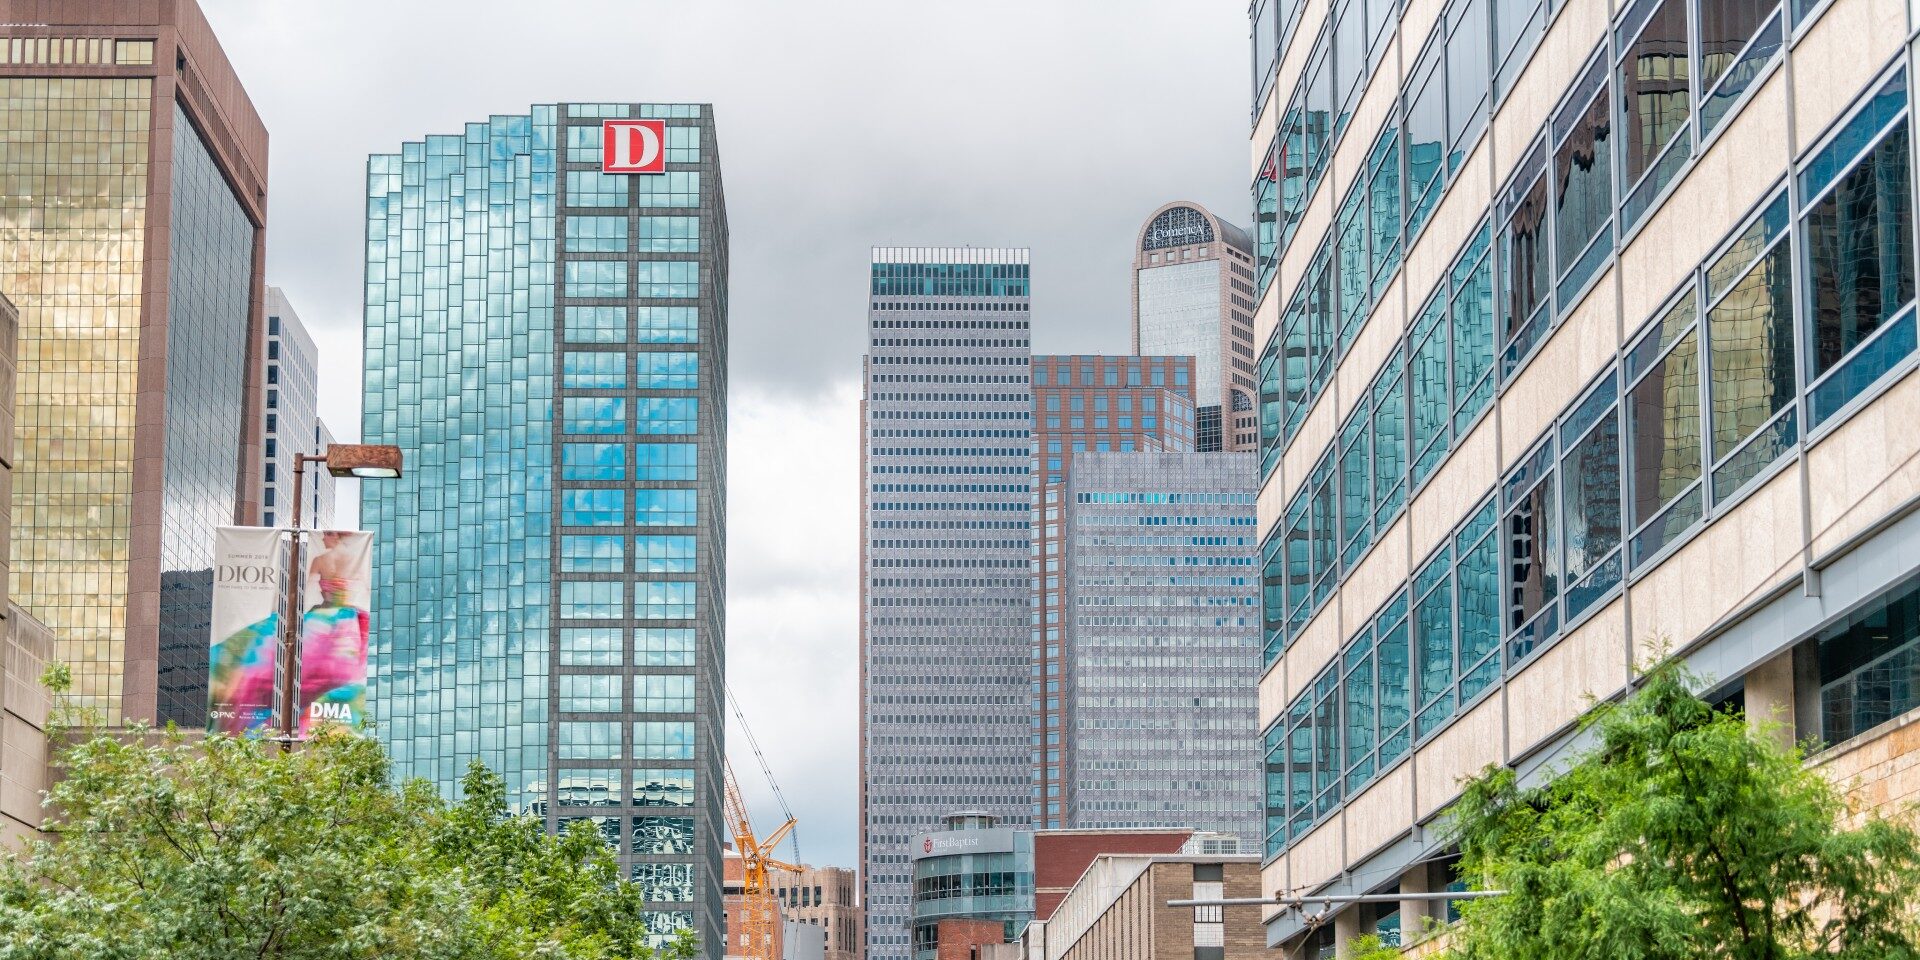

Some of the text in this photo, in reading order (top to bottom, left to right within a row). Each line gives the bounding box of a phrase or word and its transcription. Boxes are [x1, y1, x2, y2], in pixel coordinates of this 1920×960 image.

[609, 124, 660, 168] D
[217, 564, 278, 585] DIOR
[219, 711, 236, 719] PNC
[309, 702, 352, 719] DMA
